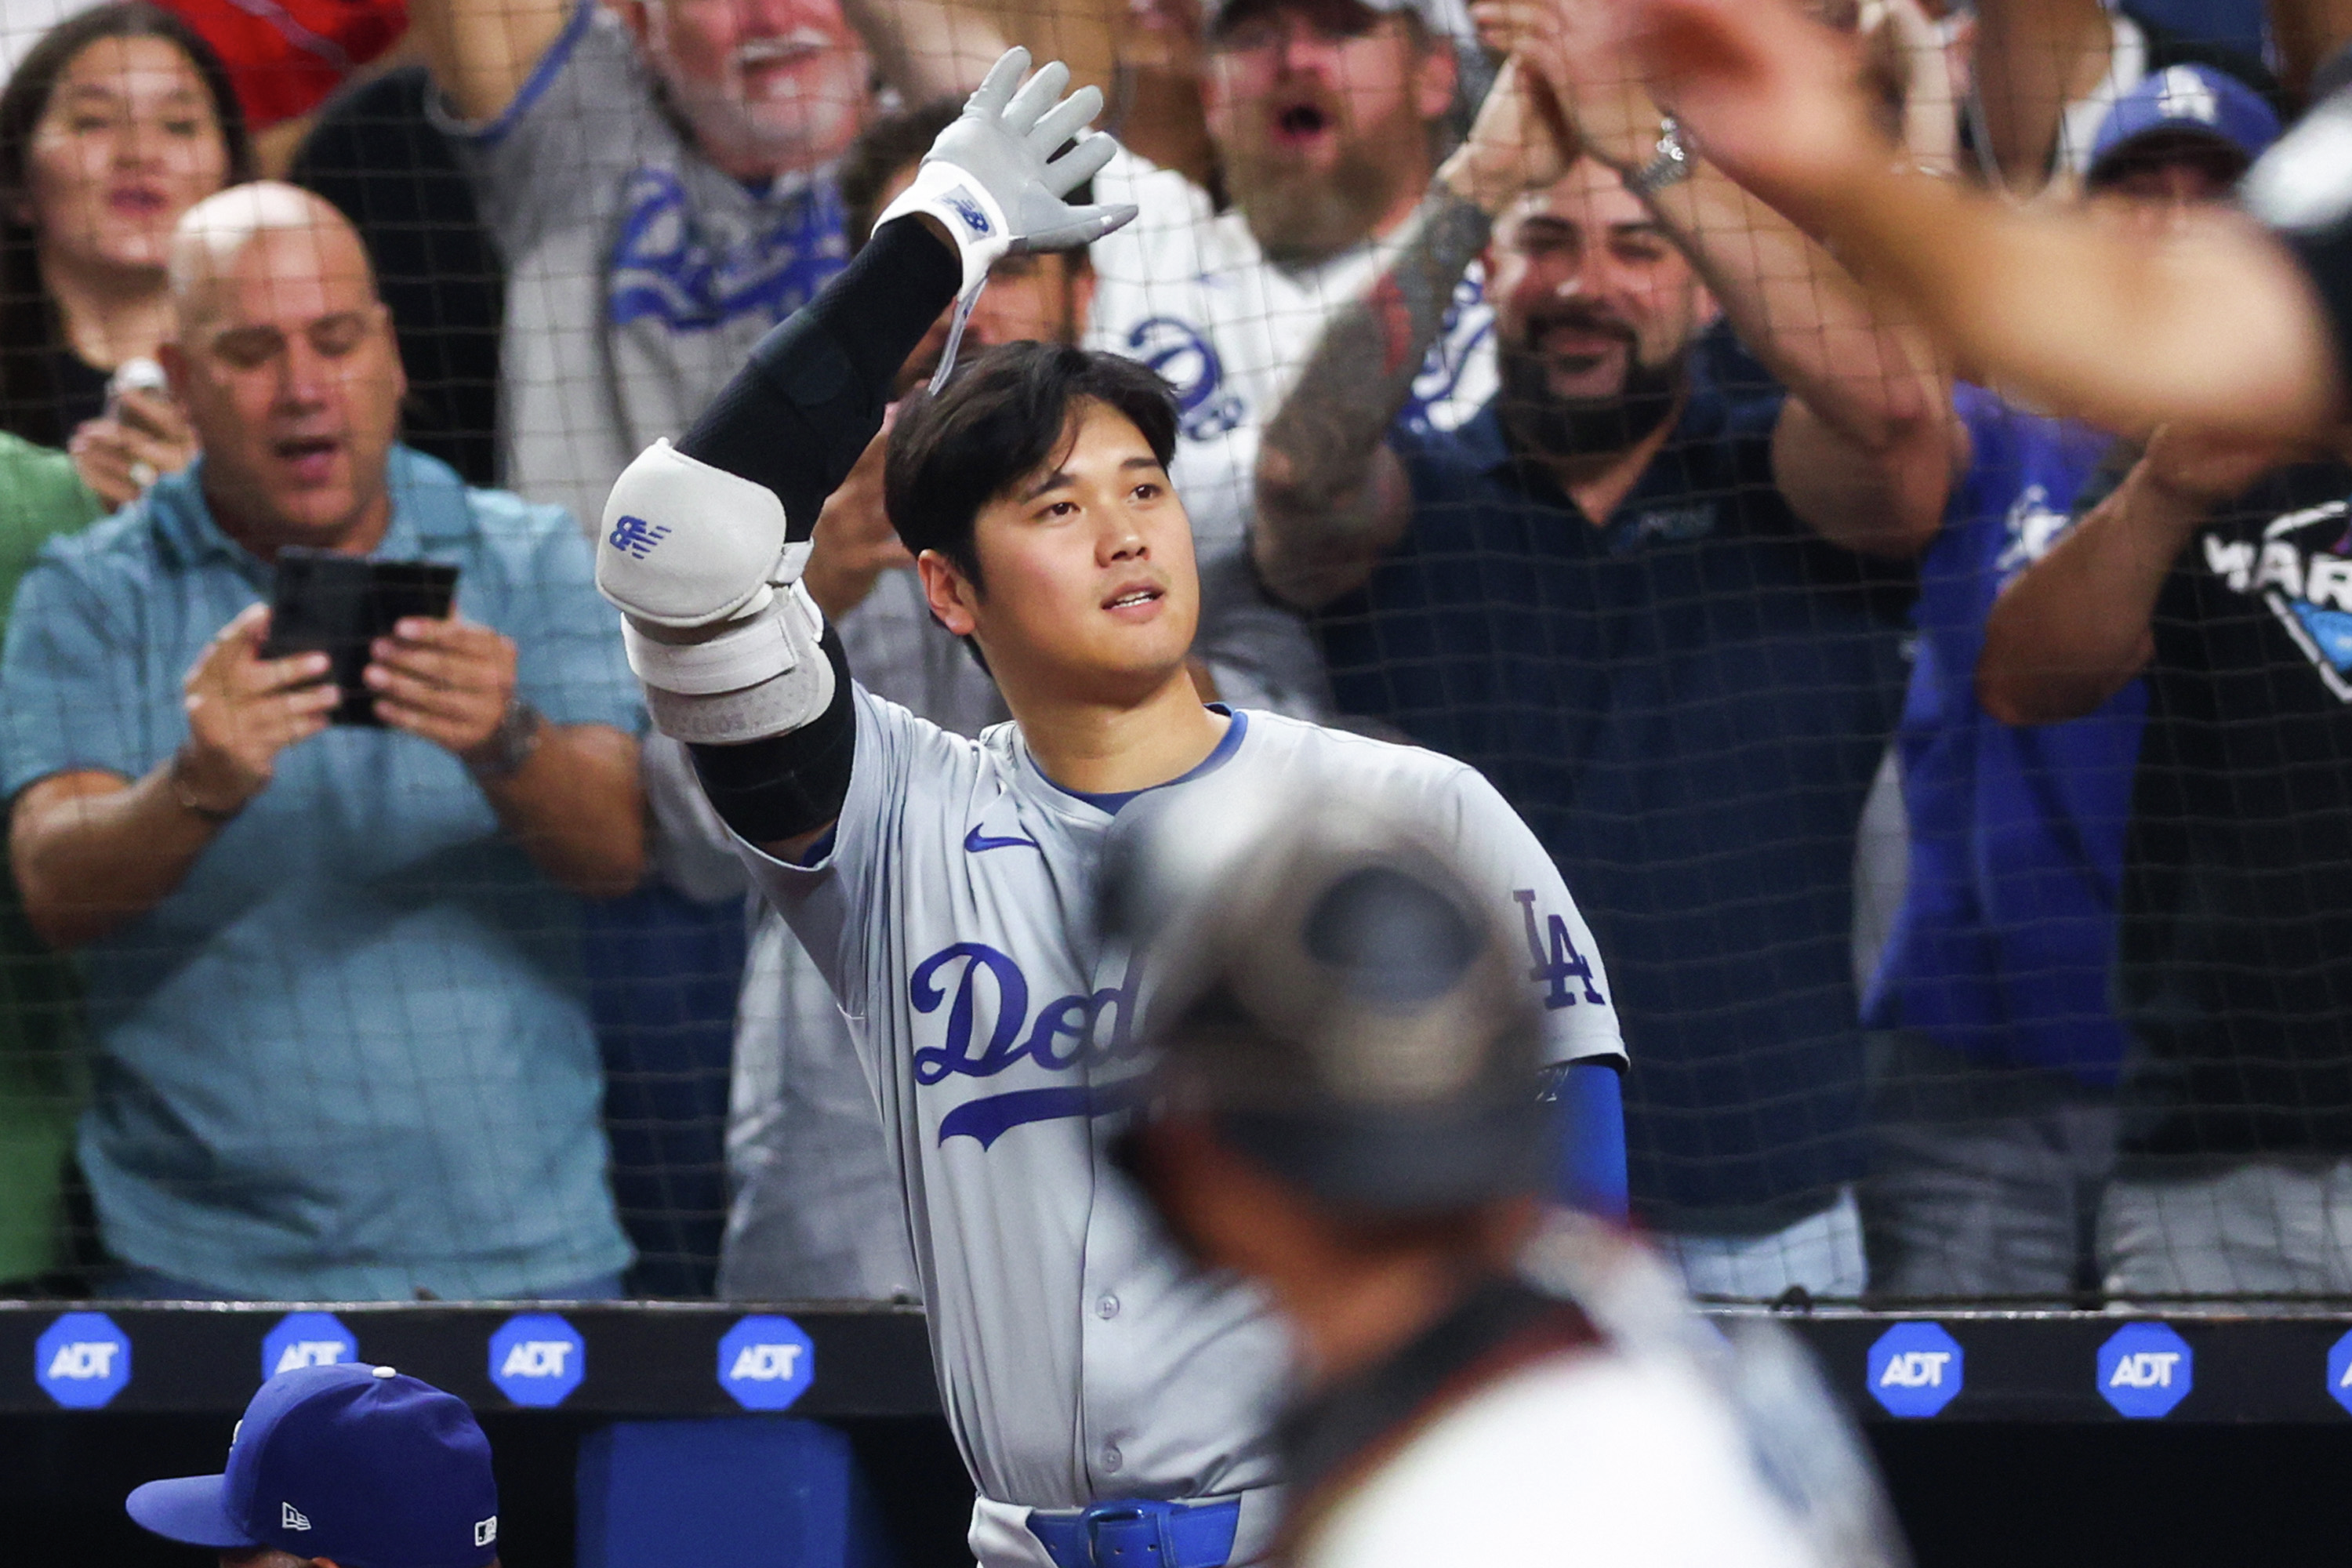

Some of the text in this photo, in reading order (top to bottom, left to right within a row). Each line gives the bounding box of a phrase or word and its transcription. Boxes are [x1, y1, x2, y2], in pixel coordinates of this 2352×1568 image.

[49, 1343, 118, 1377] ADT
[503, 1341, 572, 1376] ADT
[731, 1345, 801, 1379] ADT
[1881, 1352, 1950, 1386] ADT
[2111, 1353, 2179, 1386] ADT
